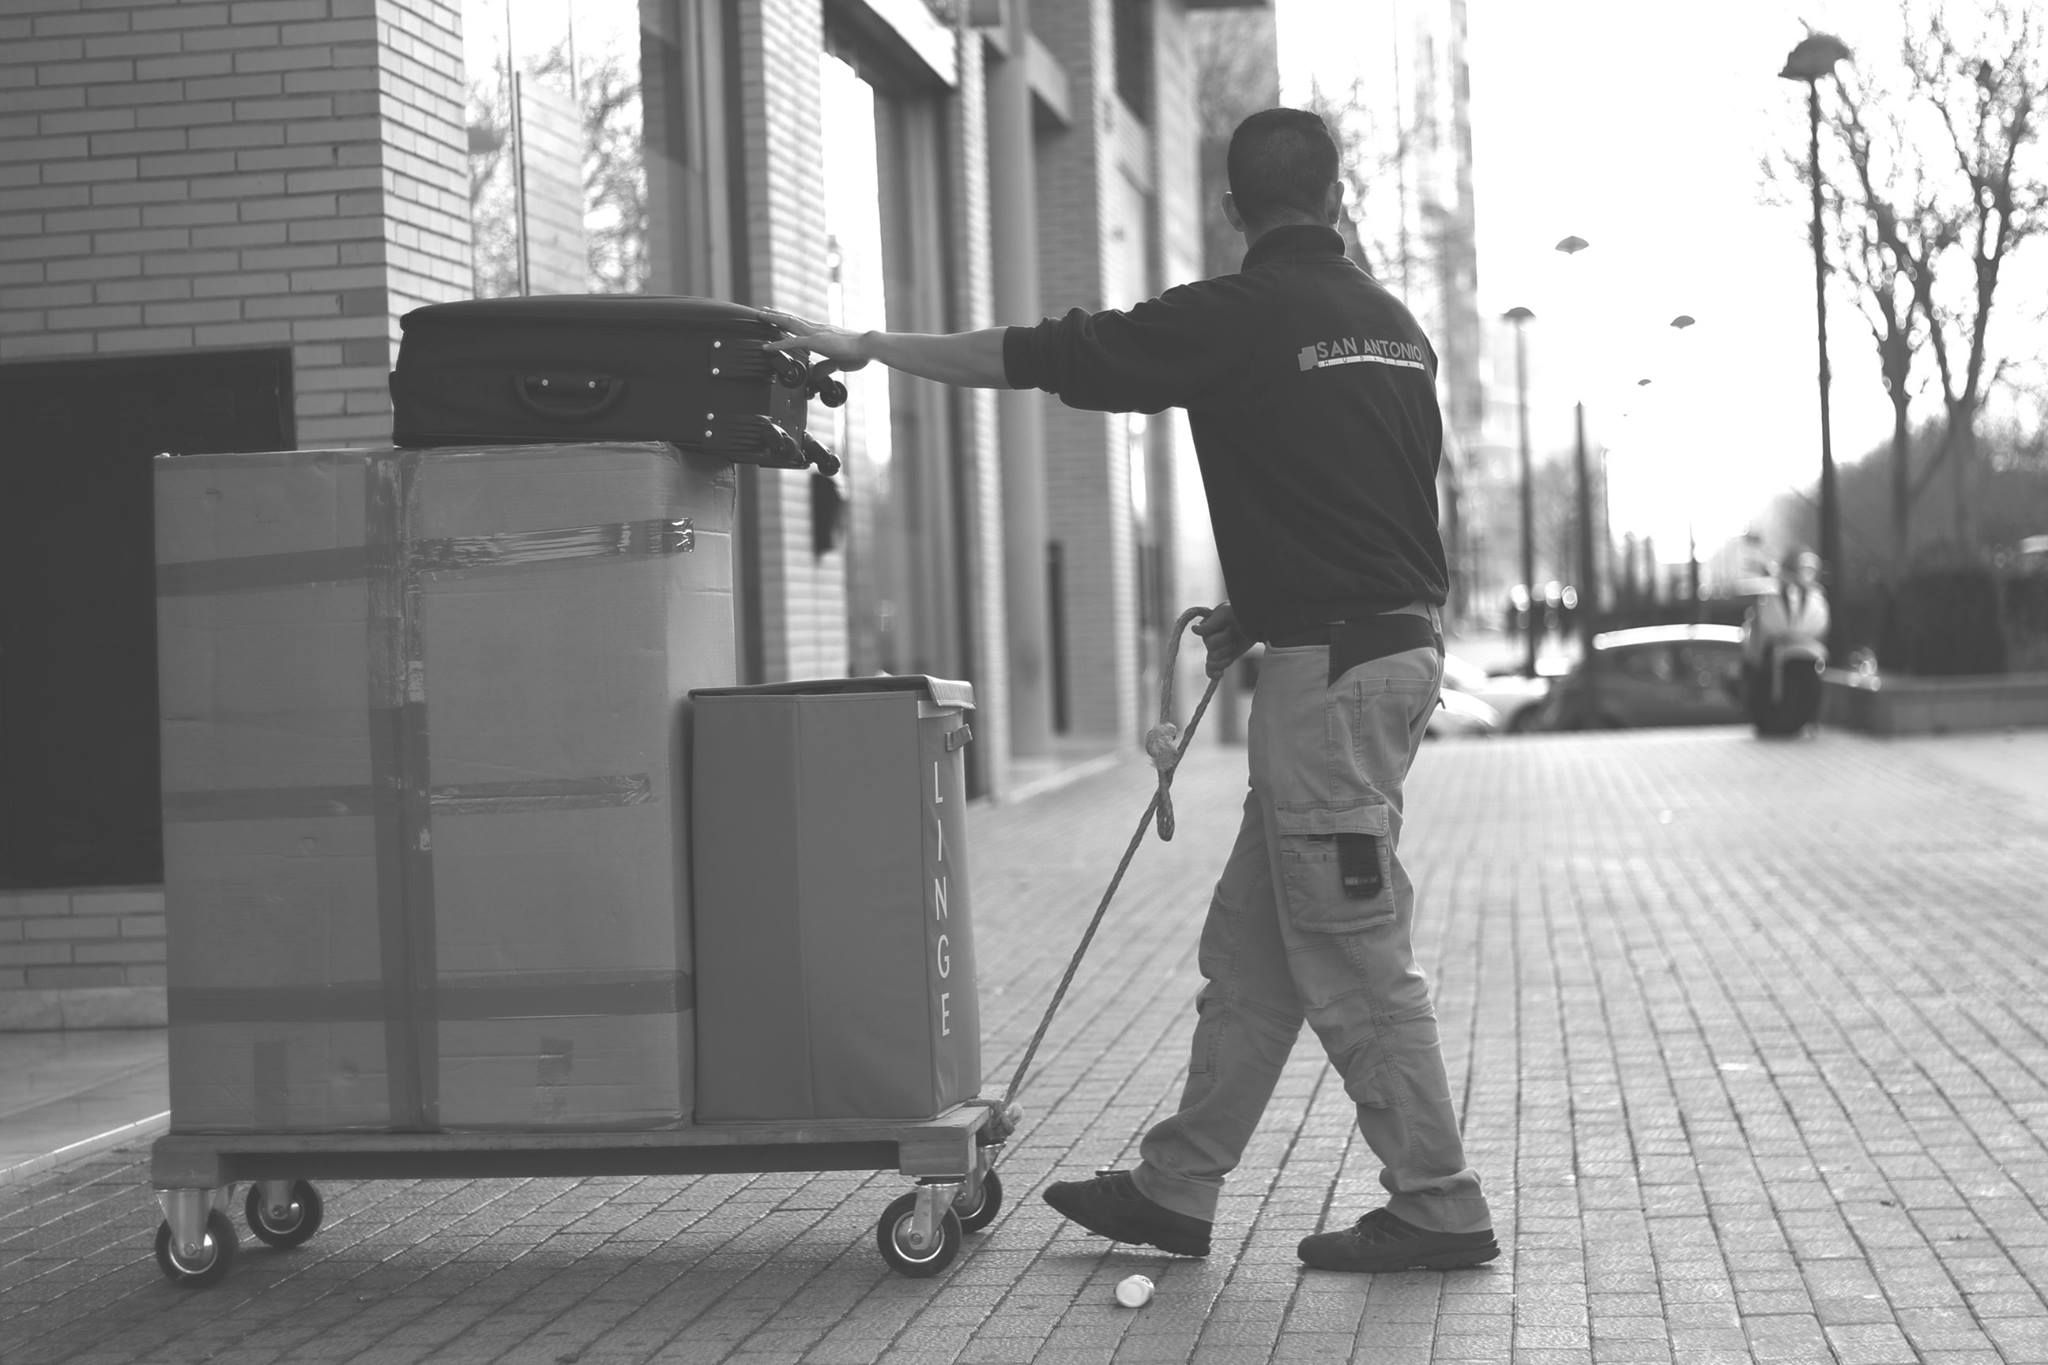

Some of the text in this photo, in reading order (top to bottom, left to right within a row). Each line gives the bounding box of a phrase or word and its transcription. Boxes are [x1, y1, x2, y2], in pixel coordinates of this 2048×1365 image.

[1316, 336, 1423, 362] SAN ANTONIO
[934, 761, 950, 1037] LINGE
